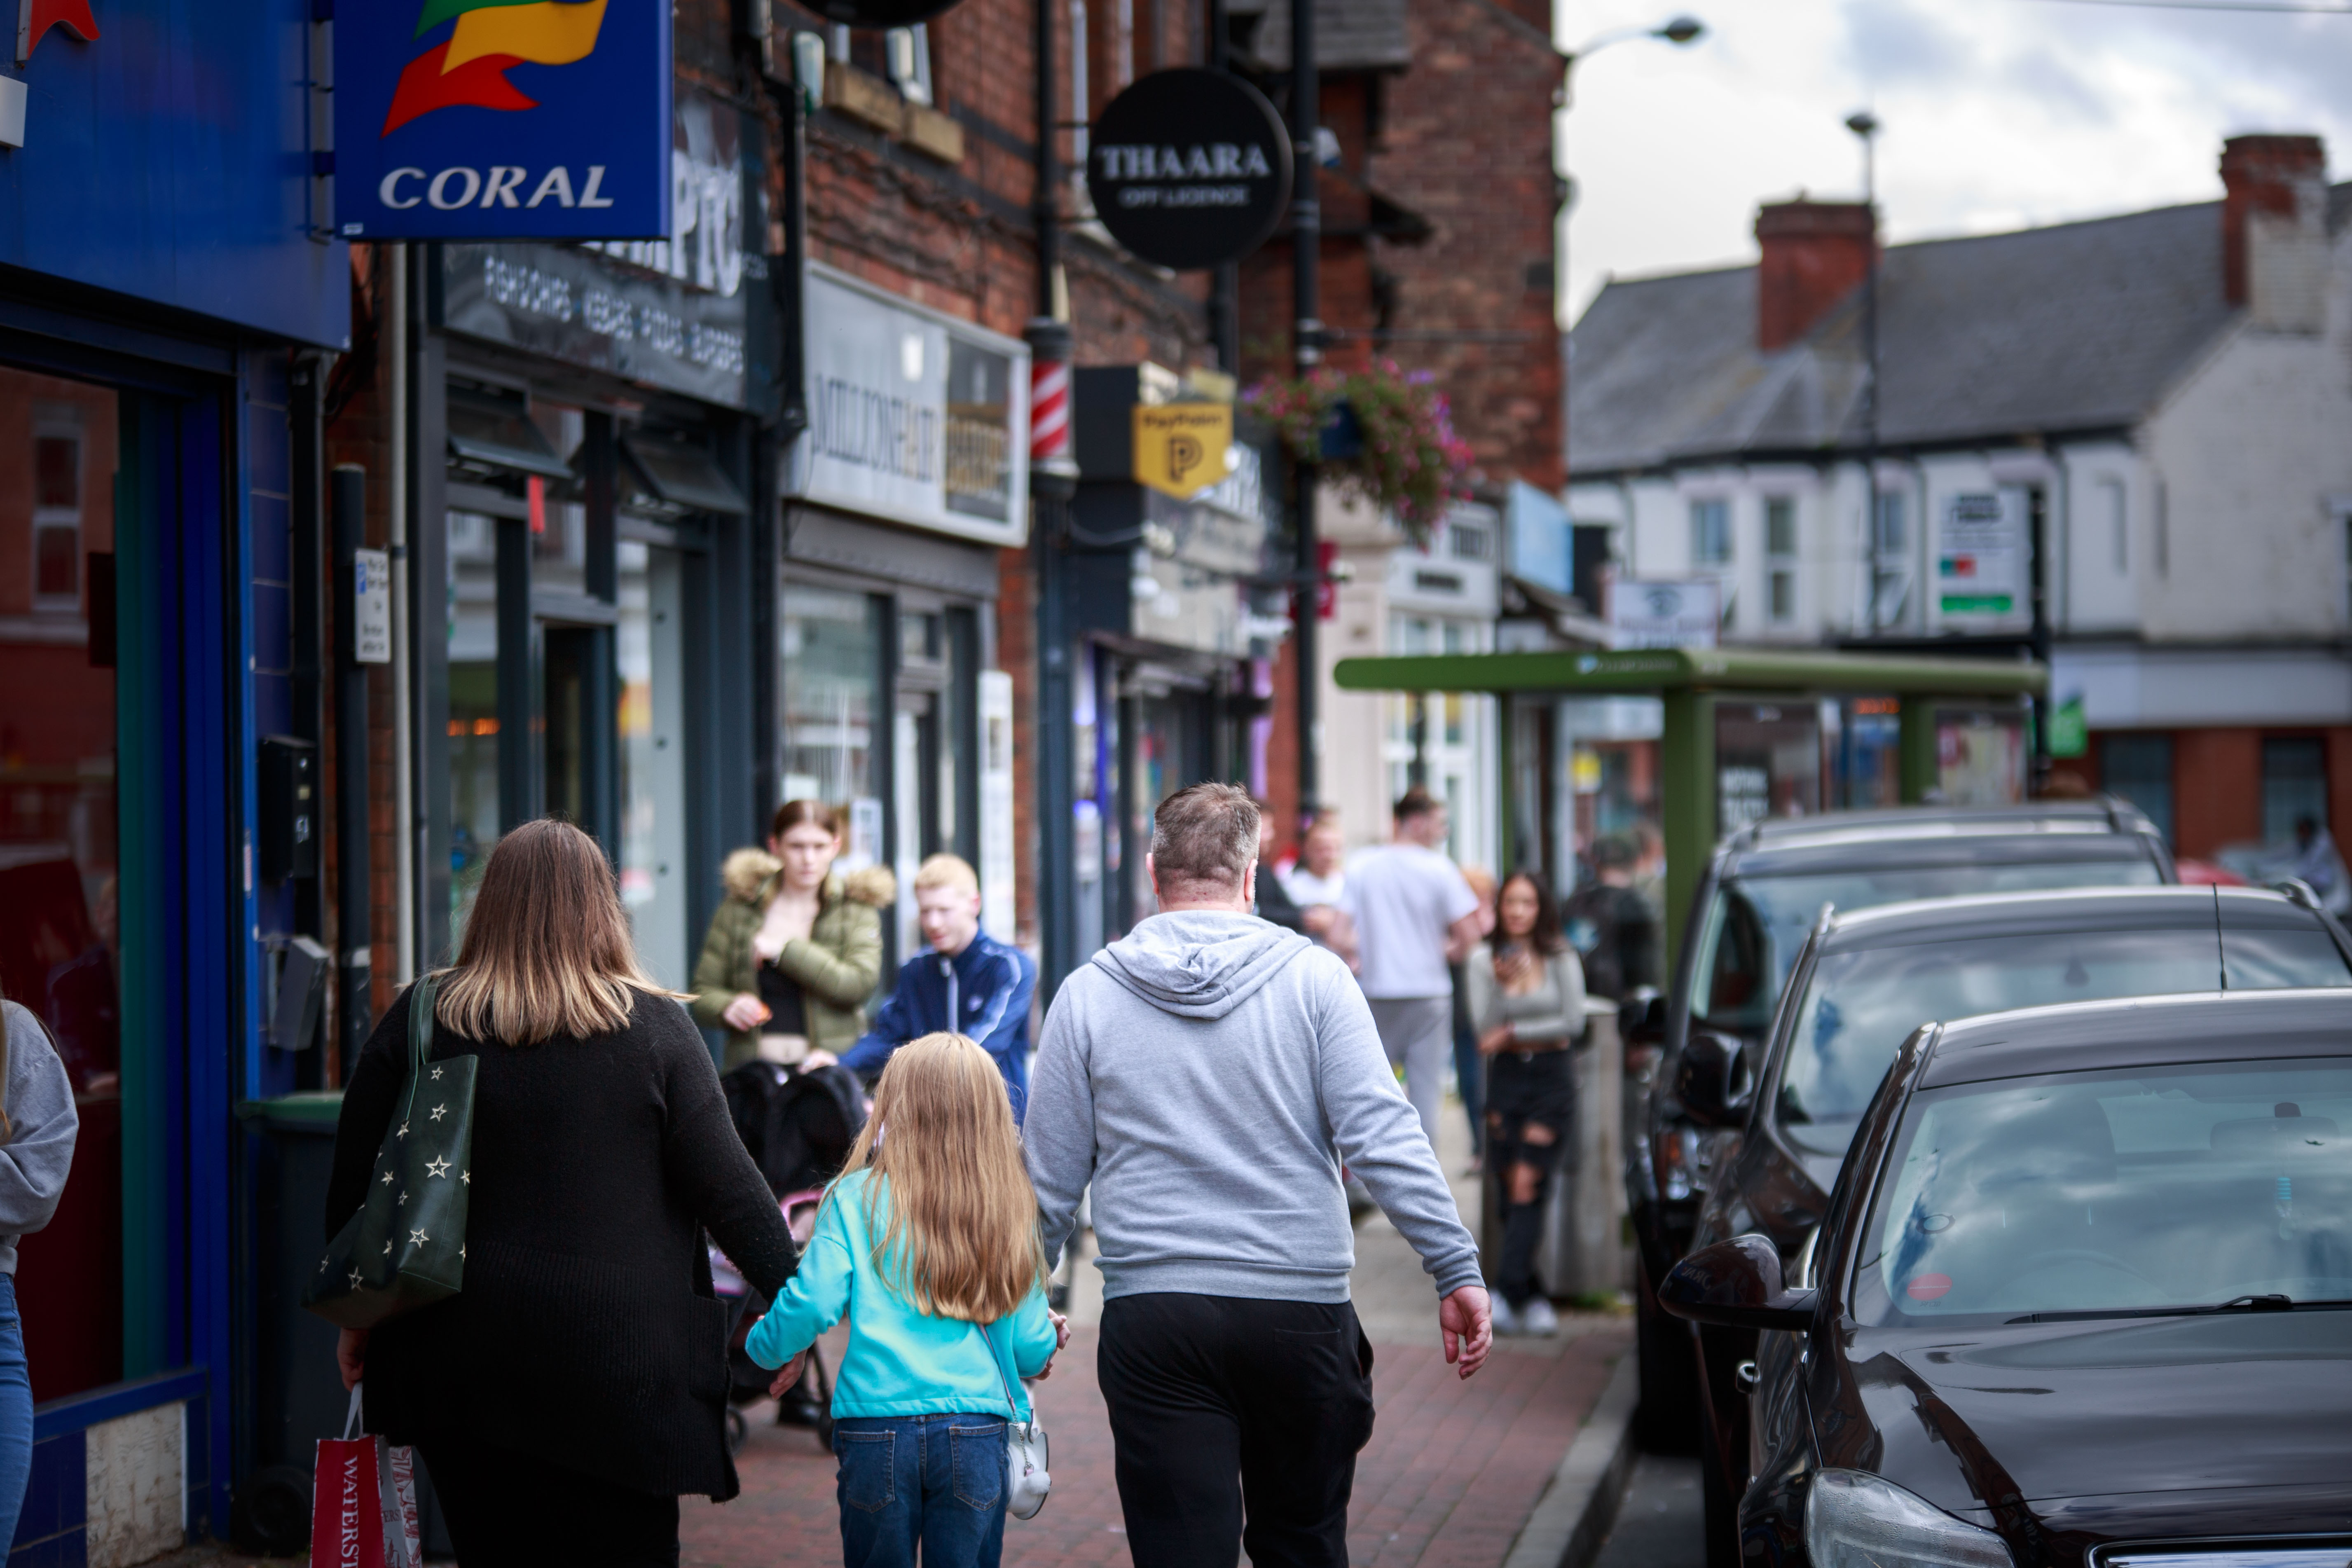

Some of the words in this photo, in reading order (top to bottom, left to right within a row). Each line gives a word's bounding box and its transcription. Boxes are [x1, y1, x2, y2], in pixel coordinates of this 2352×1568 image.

[1097, 143, 1270, 180] THAARA
[379, 166, 614, 210] CORAL
[1118, 185, 1158, 208] OFF
[1163, 185, 1250, 207] LICENCE
